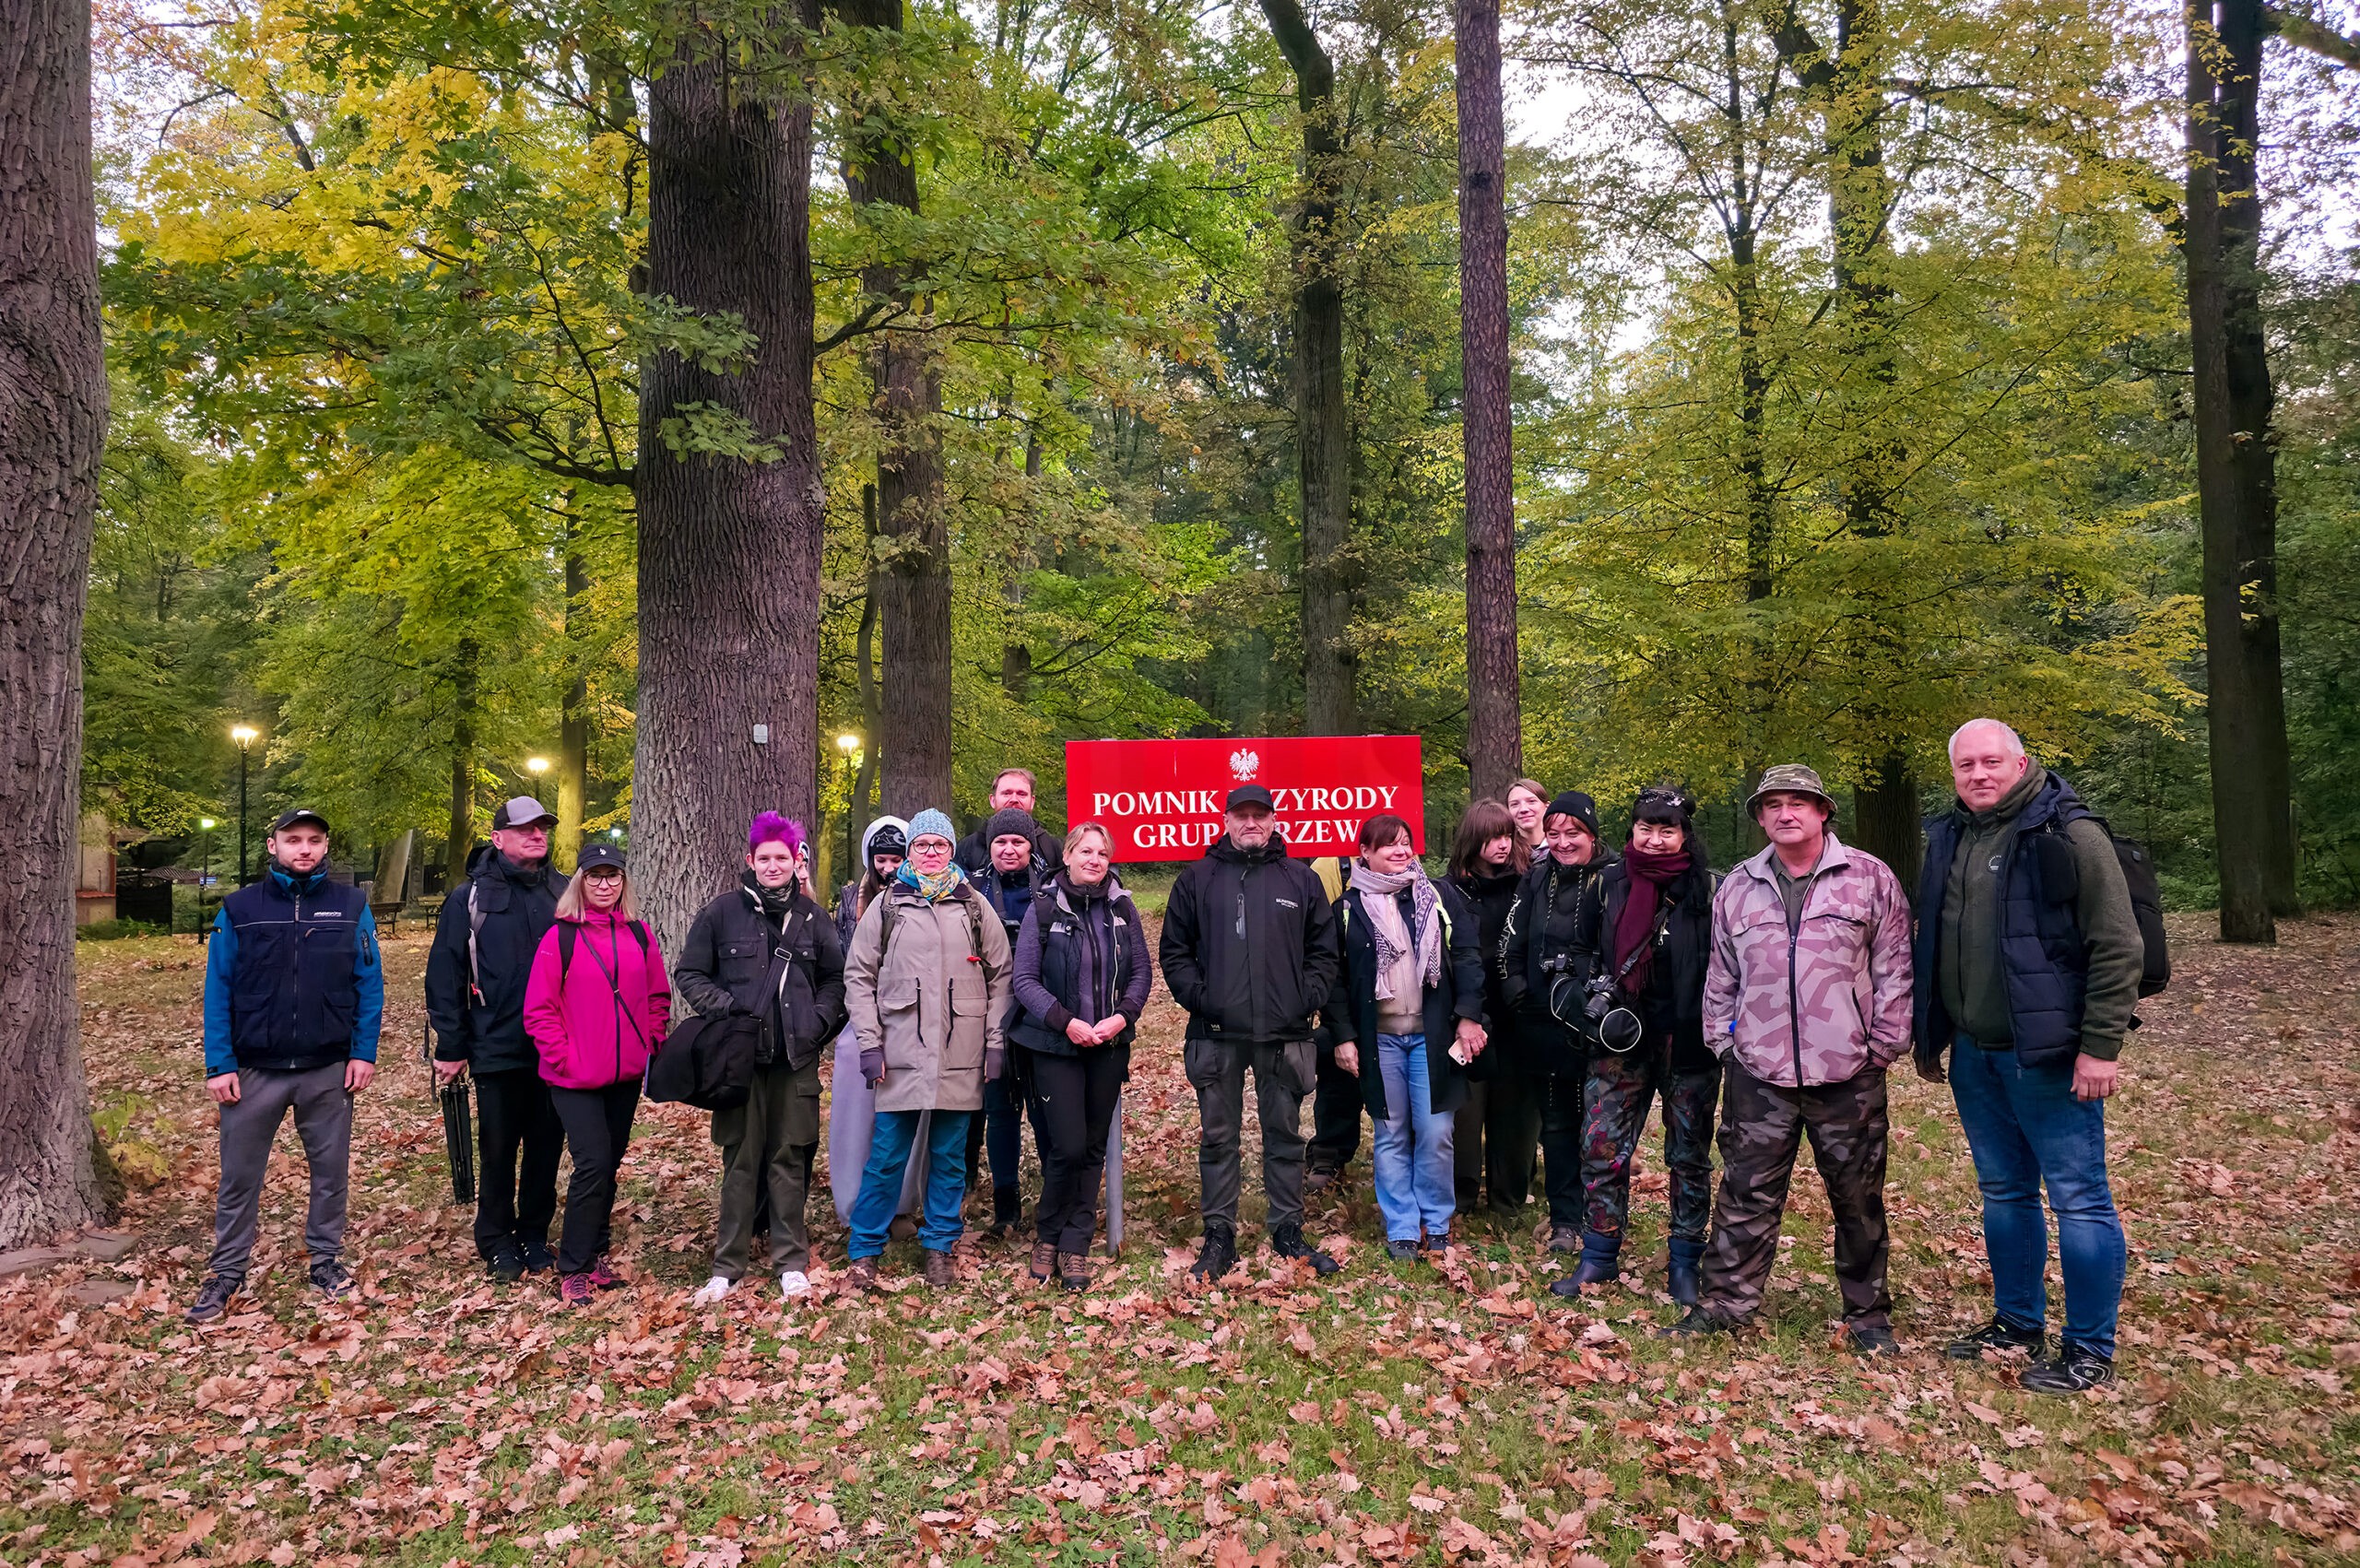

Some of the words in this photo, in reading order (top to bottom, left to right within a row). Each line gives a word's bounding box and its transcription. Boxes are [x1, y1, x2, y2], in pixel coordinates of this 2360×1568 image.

[1093, 790, 1221, 817] POMNIK
[1229, 785, 1398, 813] ZYRODY
[1132, 822, 1225, 848] GRUP
[1275, 819, 1362, 844] RZEW
